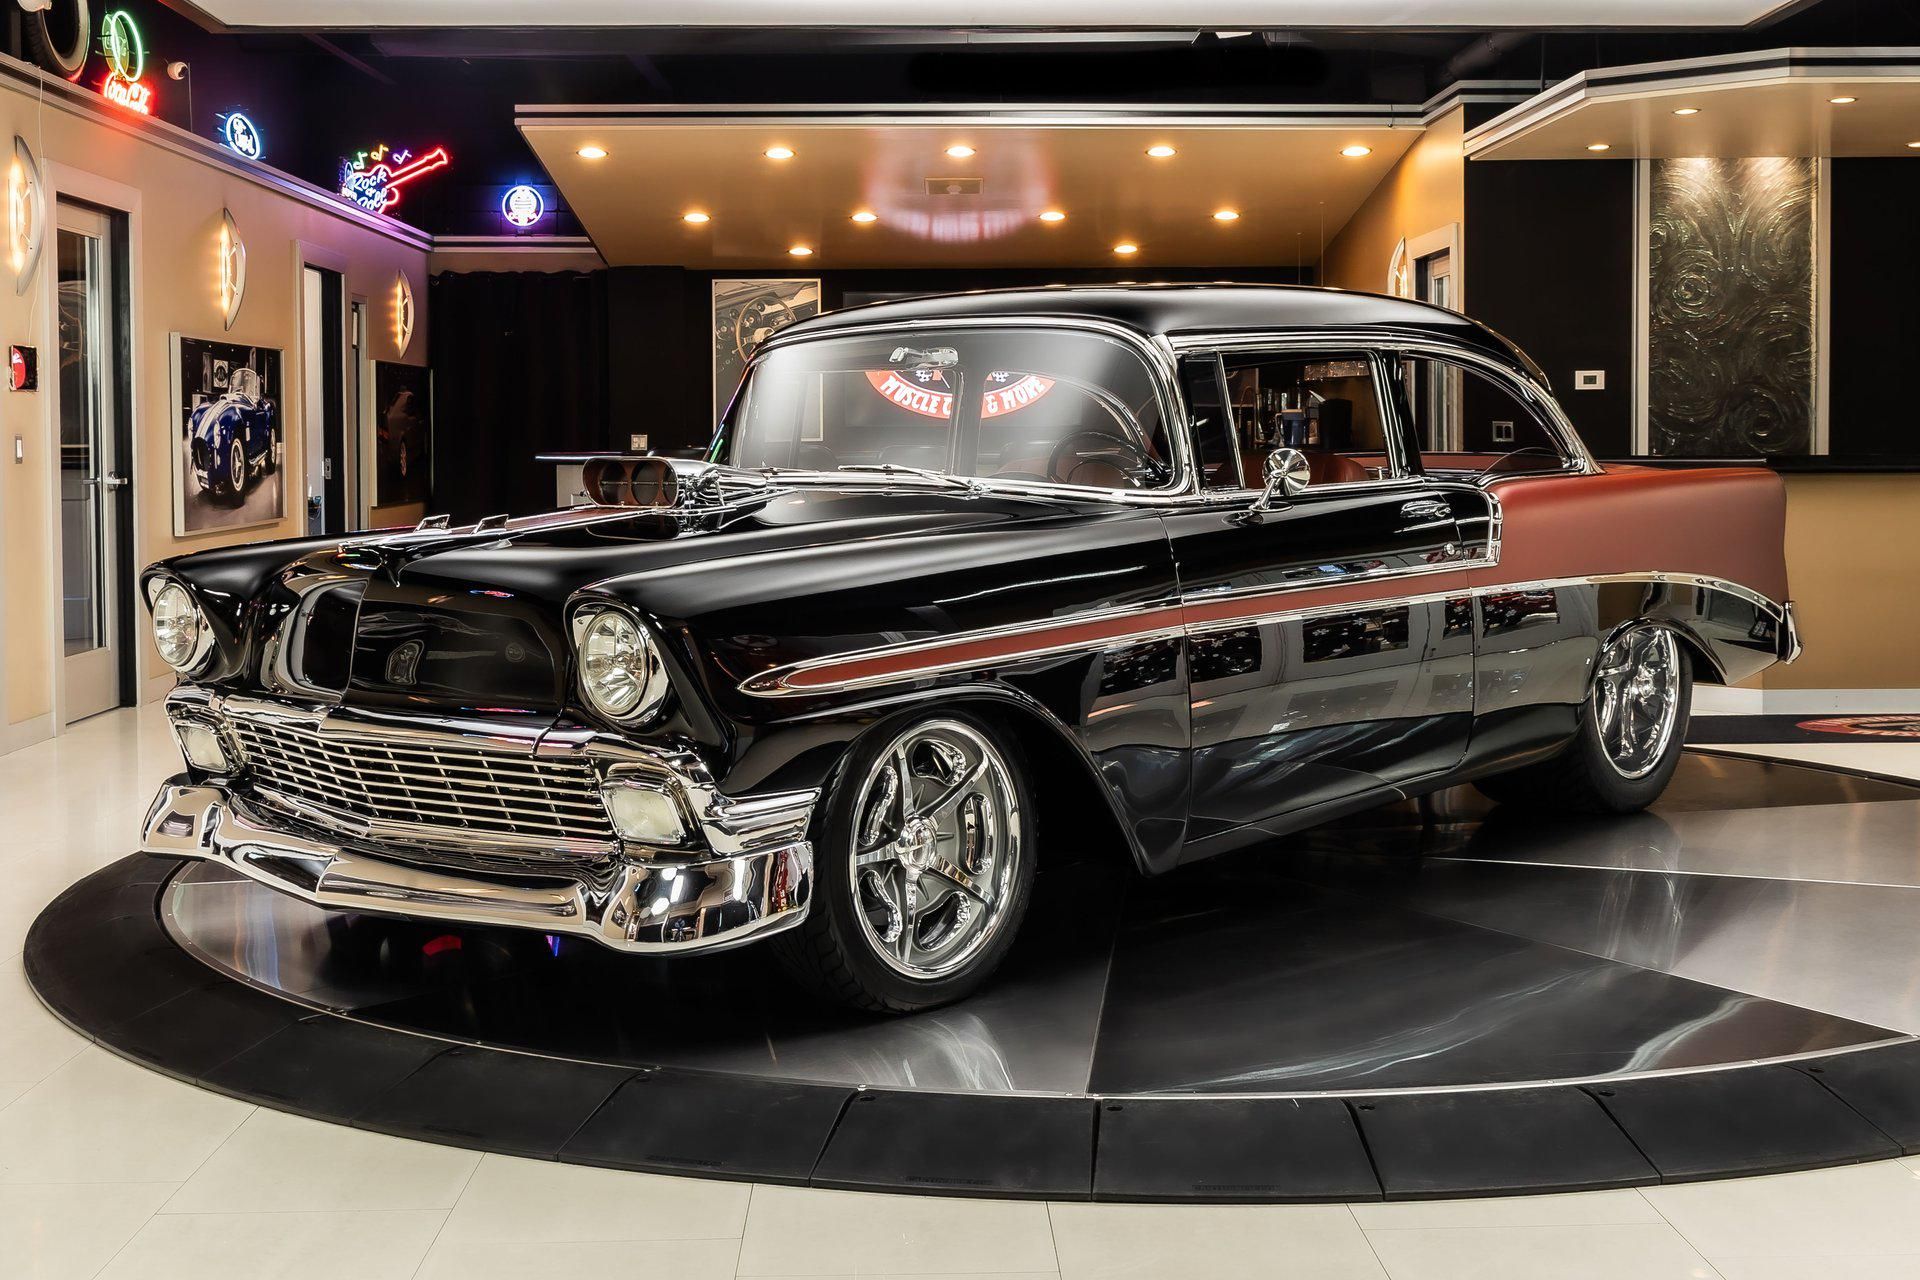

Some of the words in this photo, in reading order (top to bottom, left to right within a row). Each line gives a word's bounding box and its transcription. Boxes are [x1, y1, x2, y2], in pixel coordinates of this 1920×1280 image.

[348, 167, 388, 191] Rock
[879, 374, 940, 414] MUSCLE
[985, 394, 1000, 414] &
[1000, 375, 1046, 410] MORE
